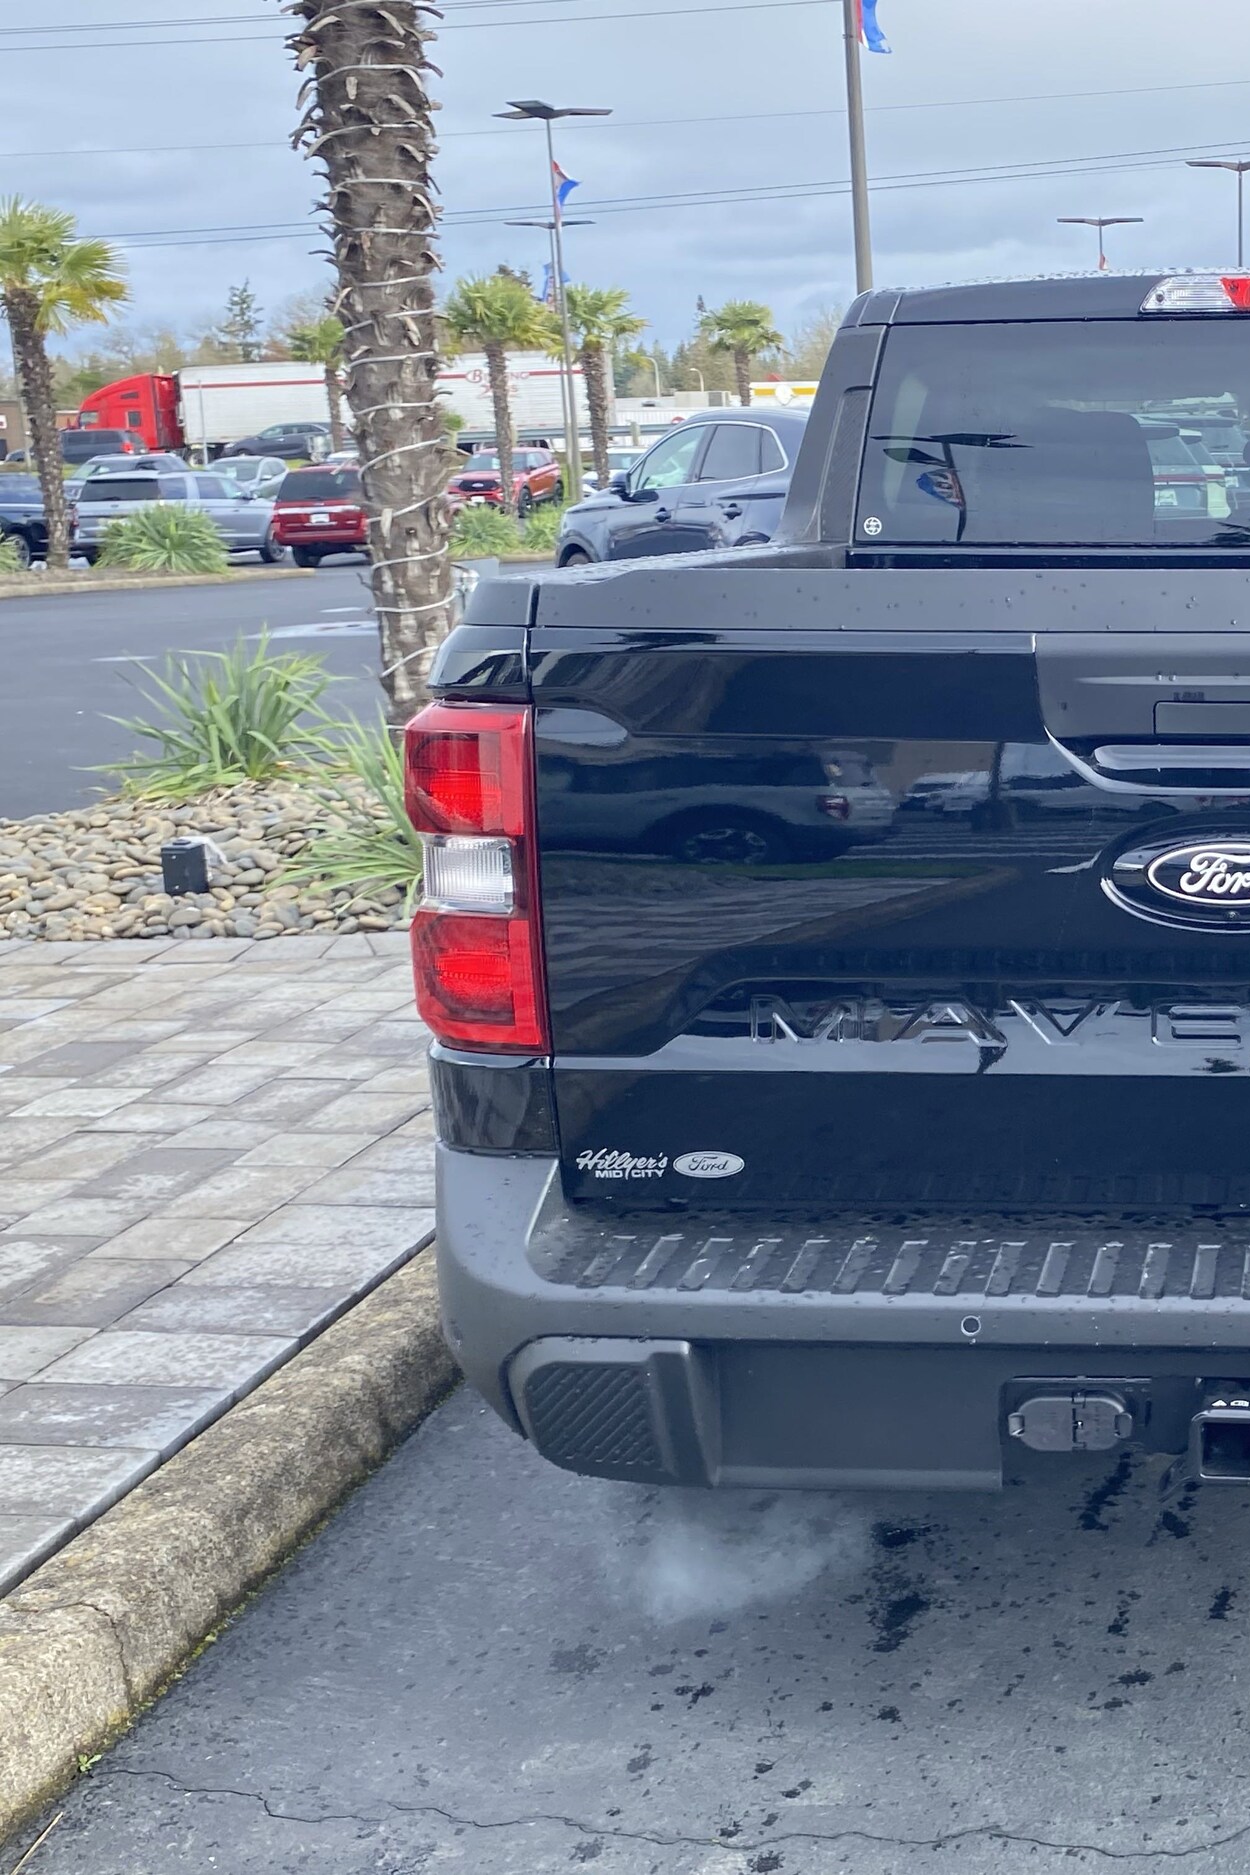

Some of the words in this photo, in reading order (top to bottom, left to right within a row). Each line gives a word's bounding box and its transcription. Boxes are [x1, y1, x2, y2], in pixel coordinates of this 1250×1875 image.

[575, 1147, 669, 1181] Hillyer's
[688, 1156, 730, 1172] Ford
[595, 1169, 624, 1179] MID
[631, 1169, 665, 1179] CITY
